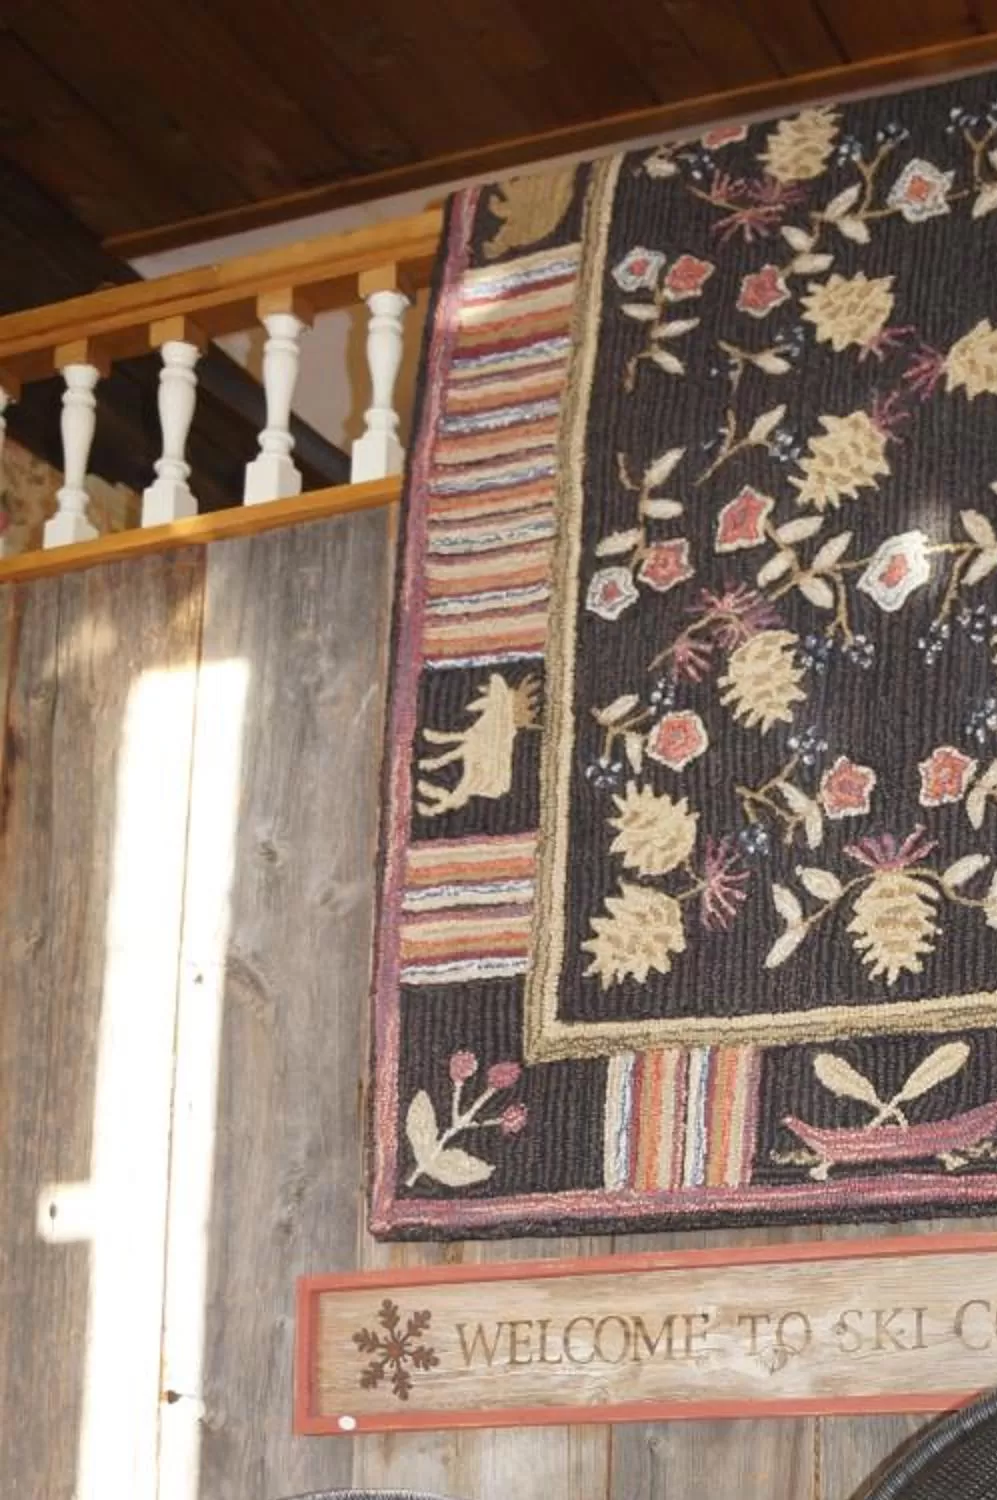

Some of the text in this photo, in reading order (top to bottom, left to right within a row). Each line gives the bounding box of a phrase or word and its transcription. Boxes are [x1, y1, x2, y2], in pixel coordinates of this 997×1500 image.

[455, 1312, 710, 1367] WELCOME
[738, 1310, 813, 1357] TO
[836, 1305, 929, 1353] SKI
